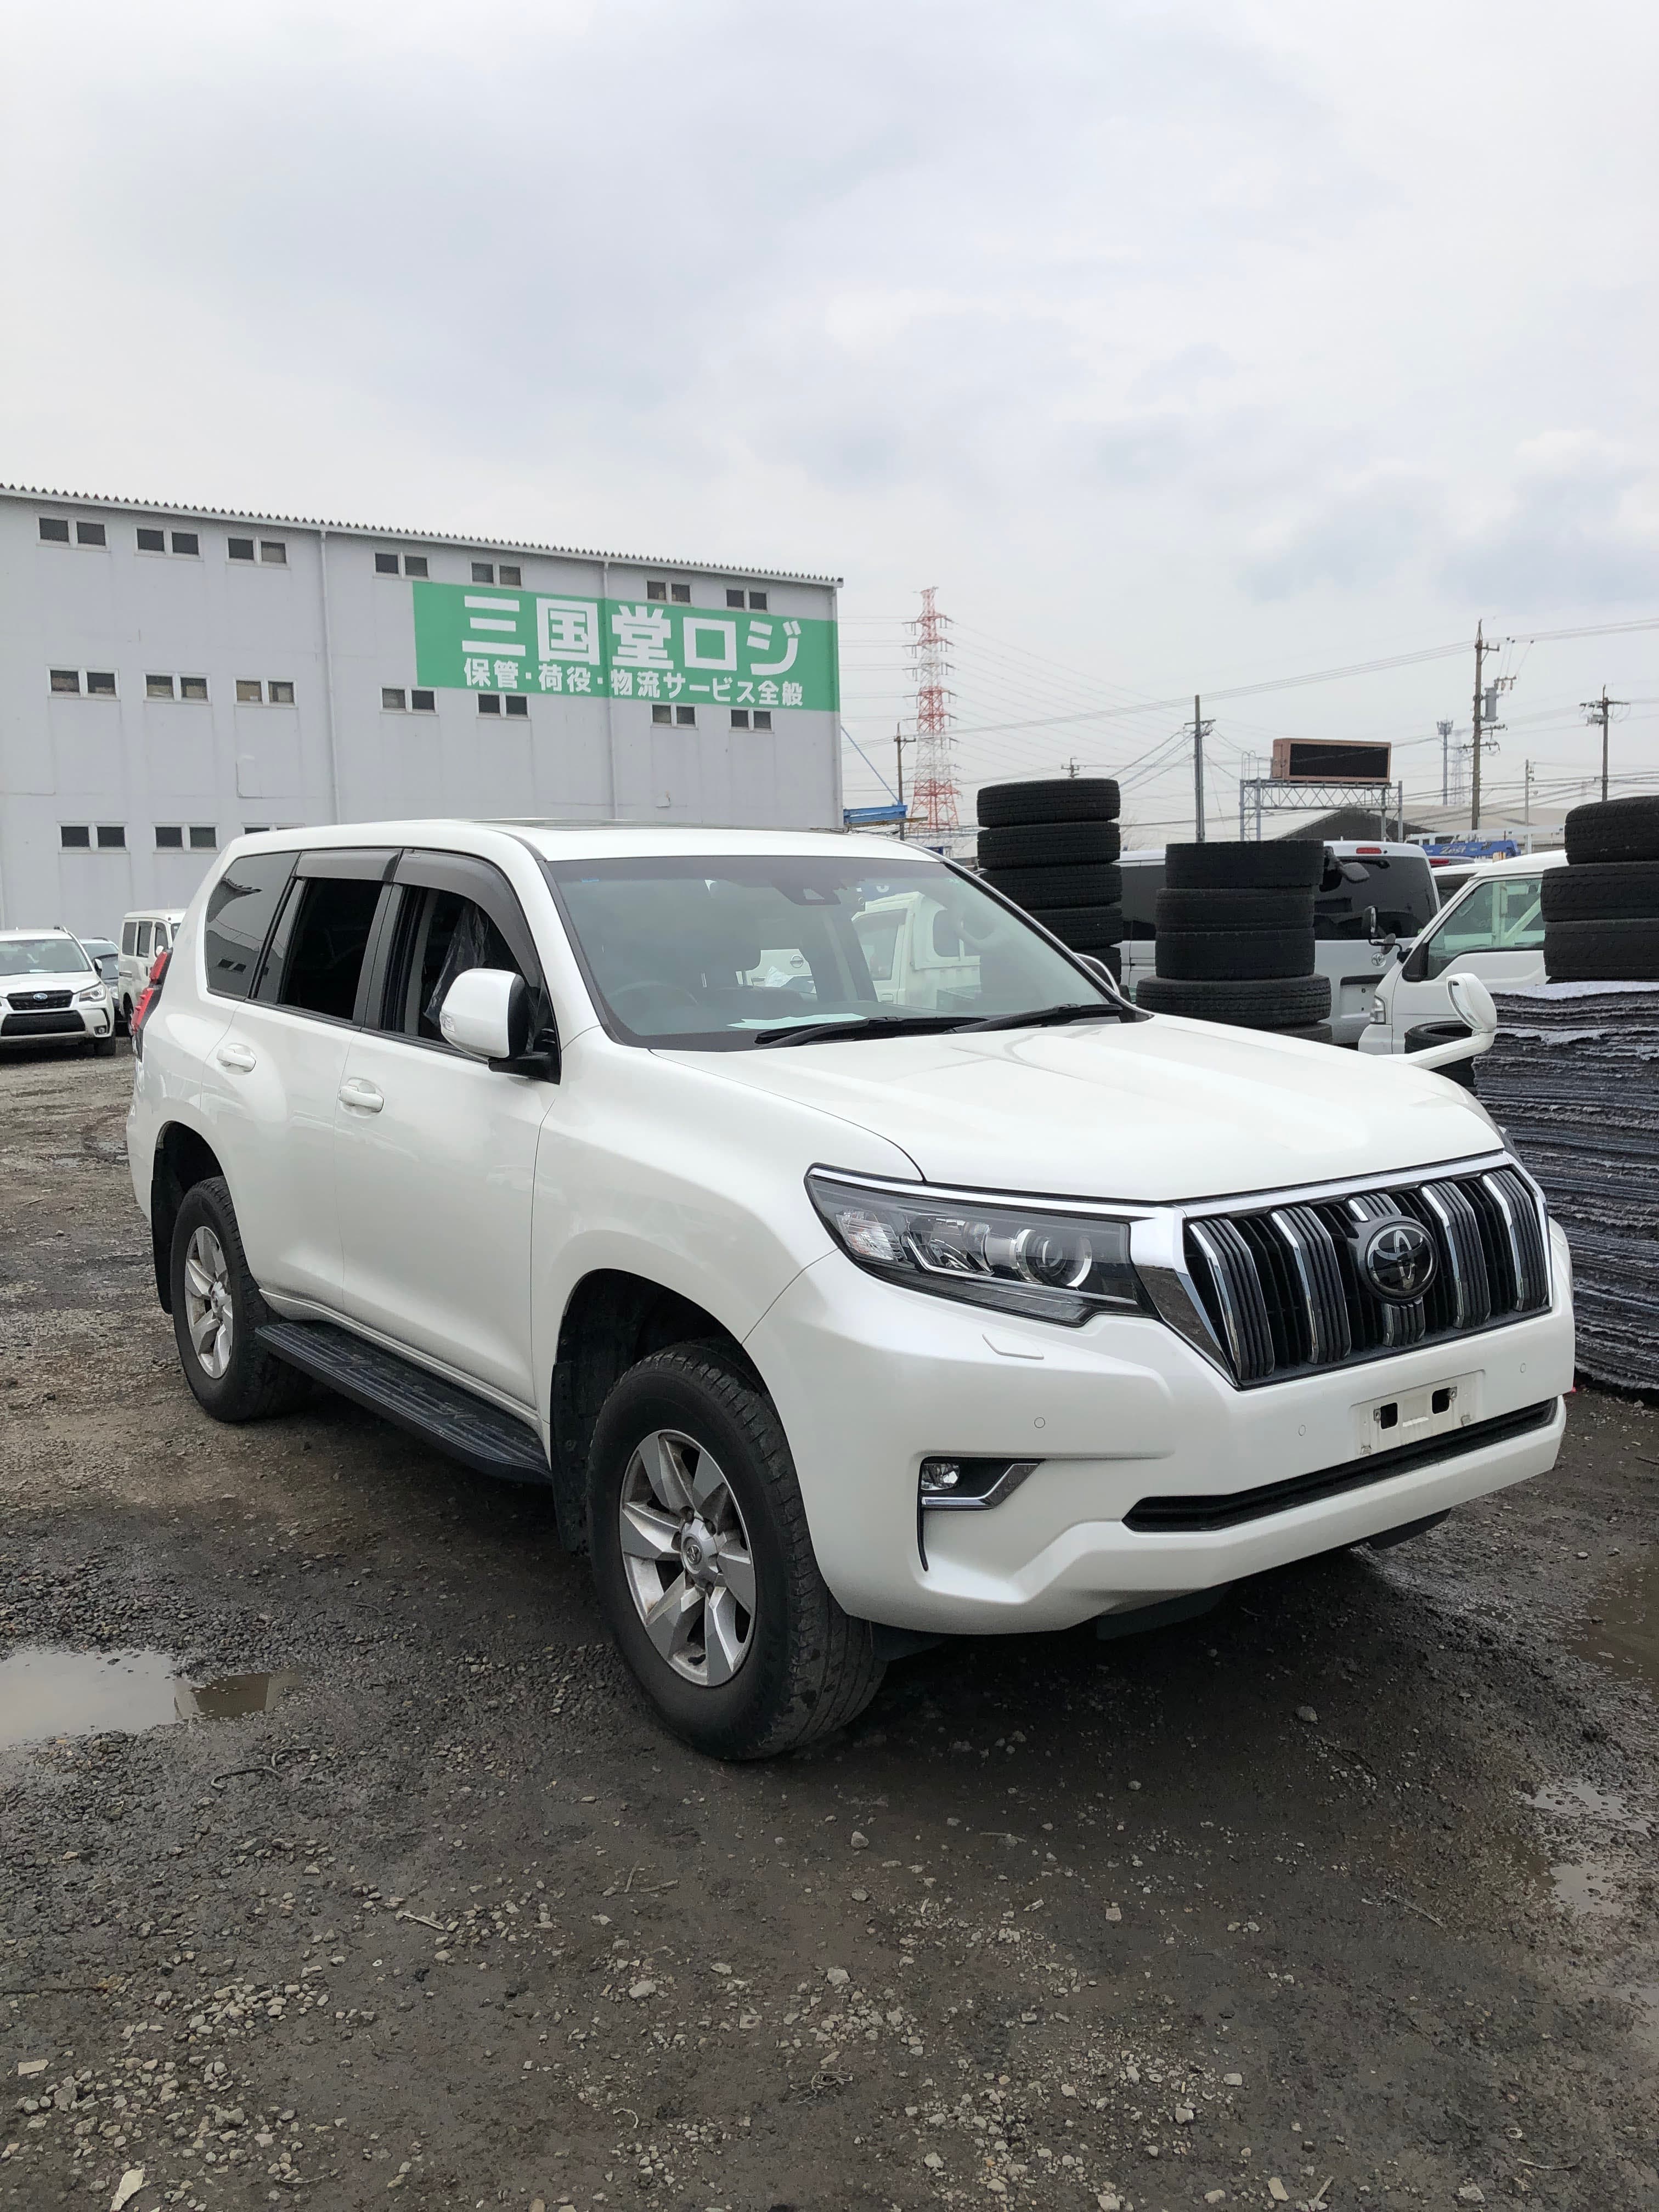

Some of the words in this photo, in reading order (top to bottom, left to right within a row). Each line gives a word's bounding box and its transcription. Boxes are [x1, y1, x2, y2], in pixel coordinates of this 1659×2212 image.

[462, 596, 802, 675] 三国堂ロジ
